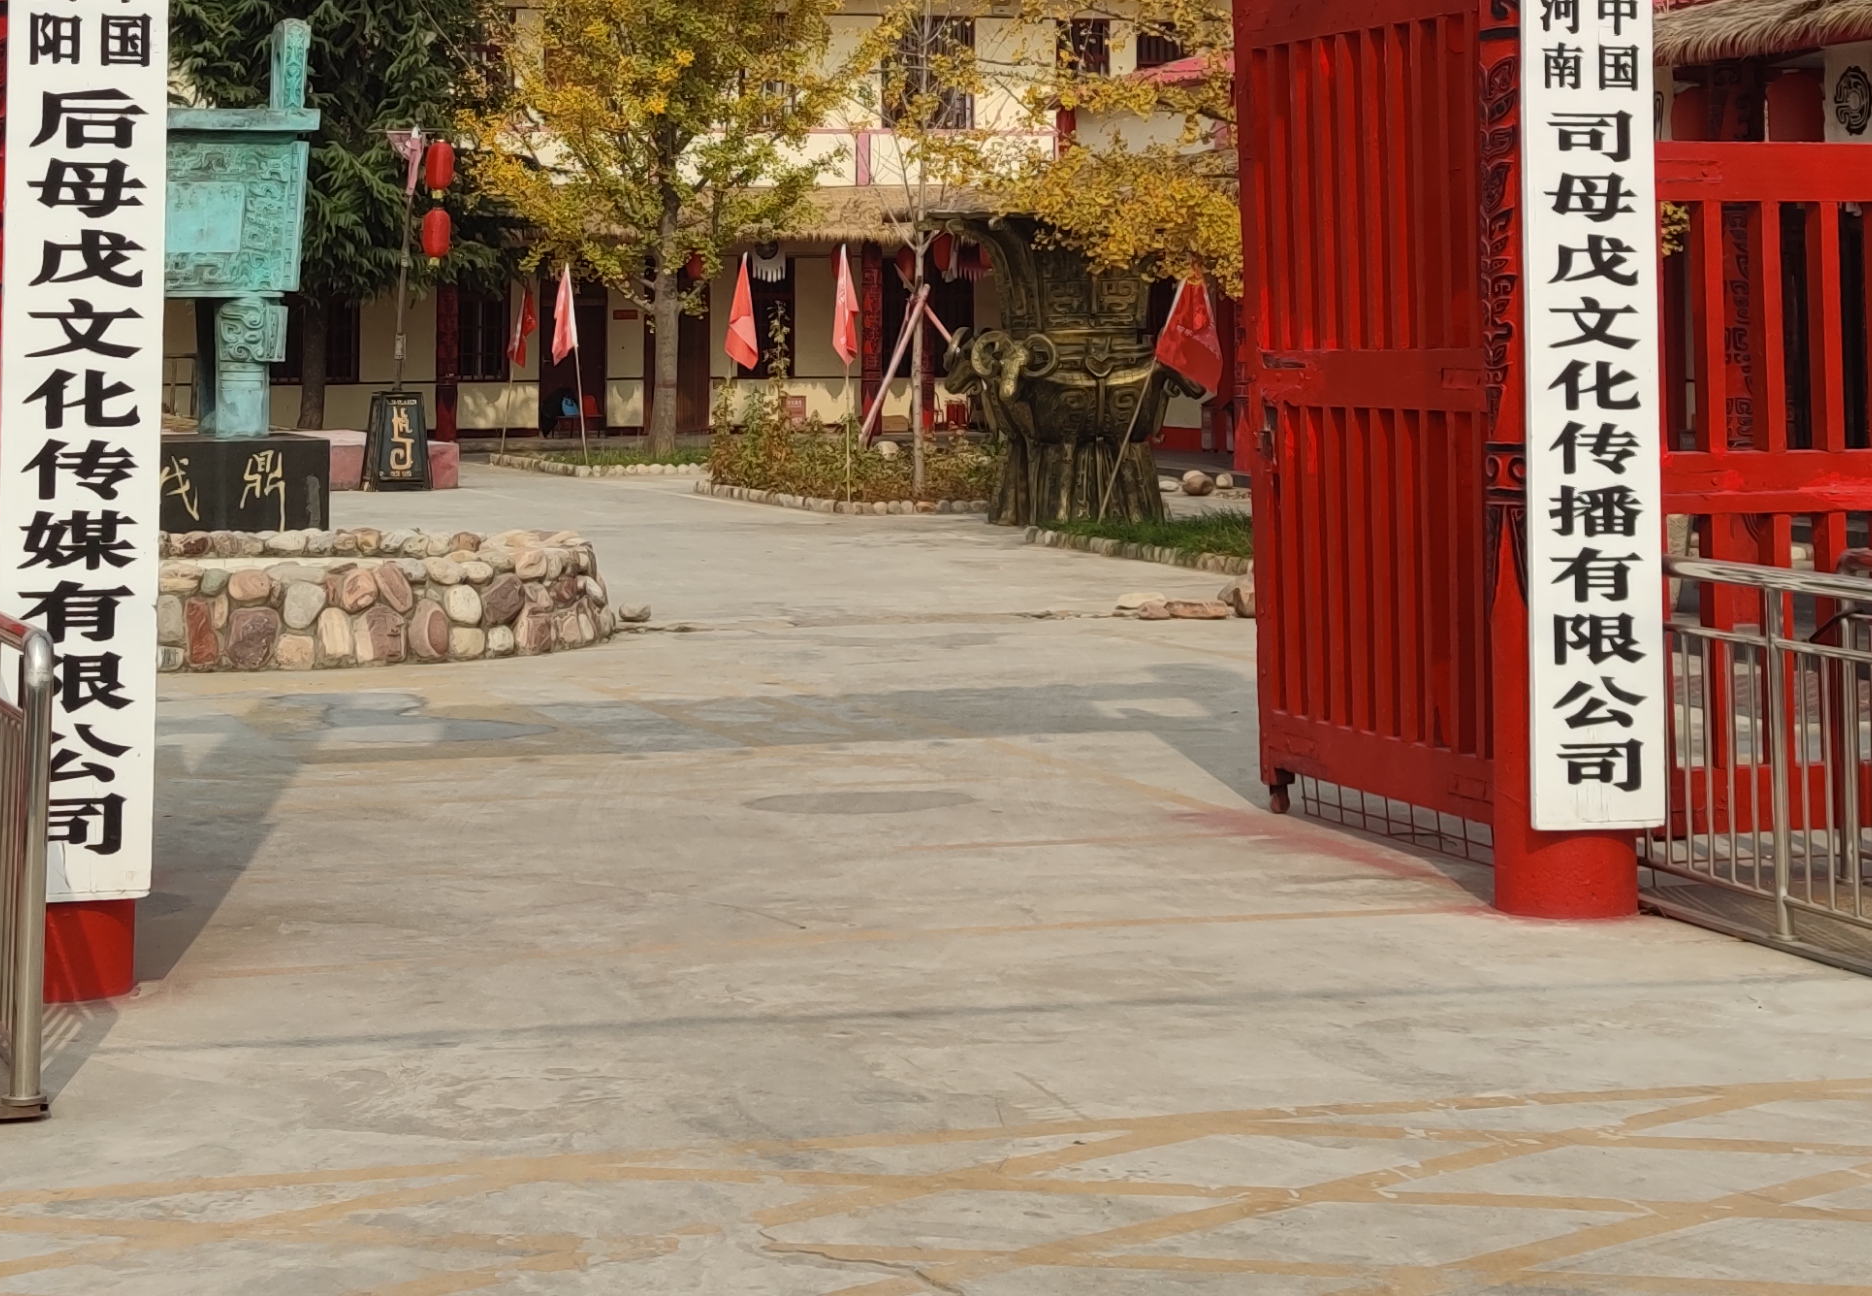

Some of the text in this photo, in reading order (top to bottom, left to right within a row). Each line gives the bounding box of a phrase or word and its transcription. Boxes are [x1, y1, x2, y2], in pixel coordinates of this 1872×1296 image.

[17, 88, 150, 855] 后母戊文化传媒有限公司
[1543, 109, 1648, 792] 司母戊文化传播有限公司
